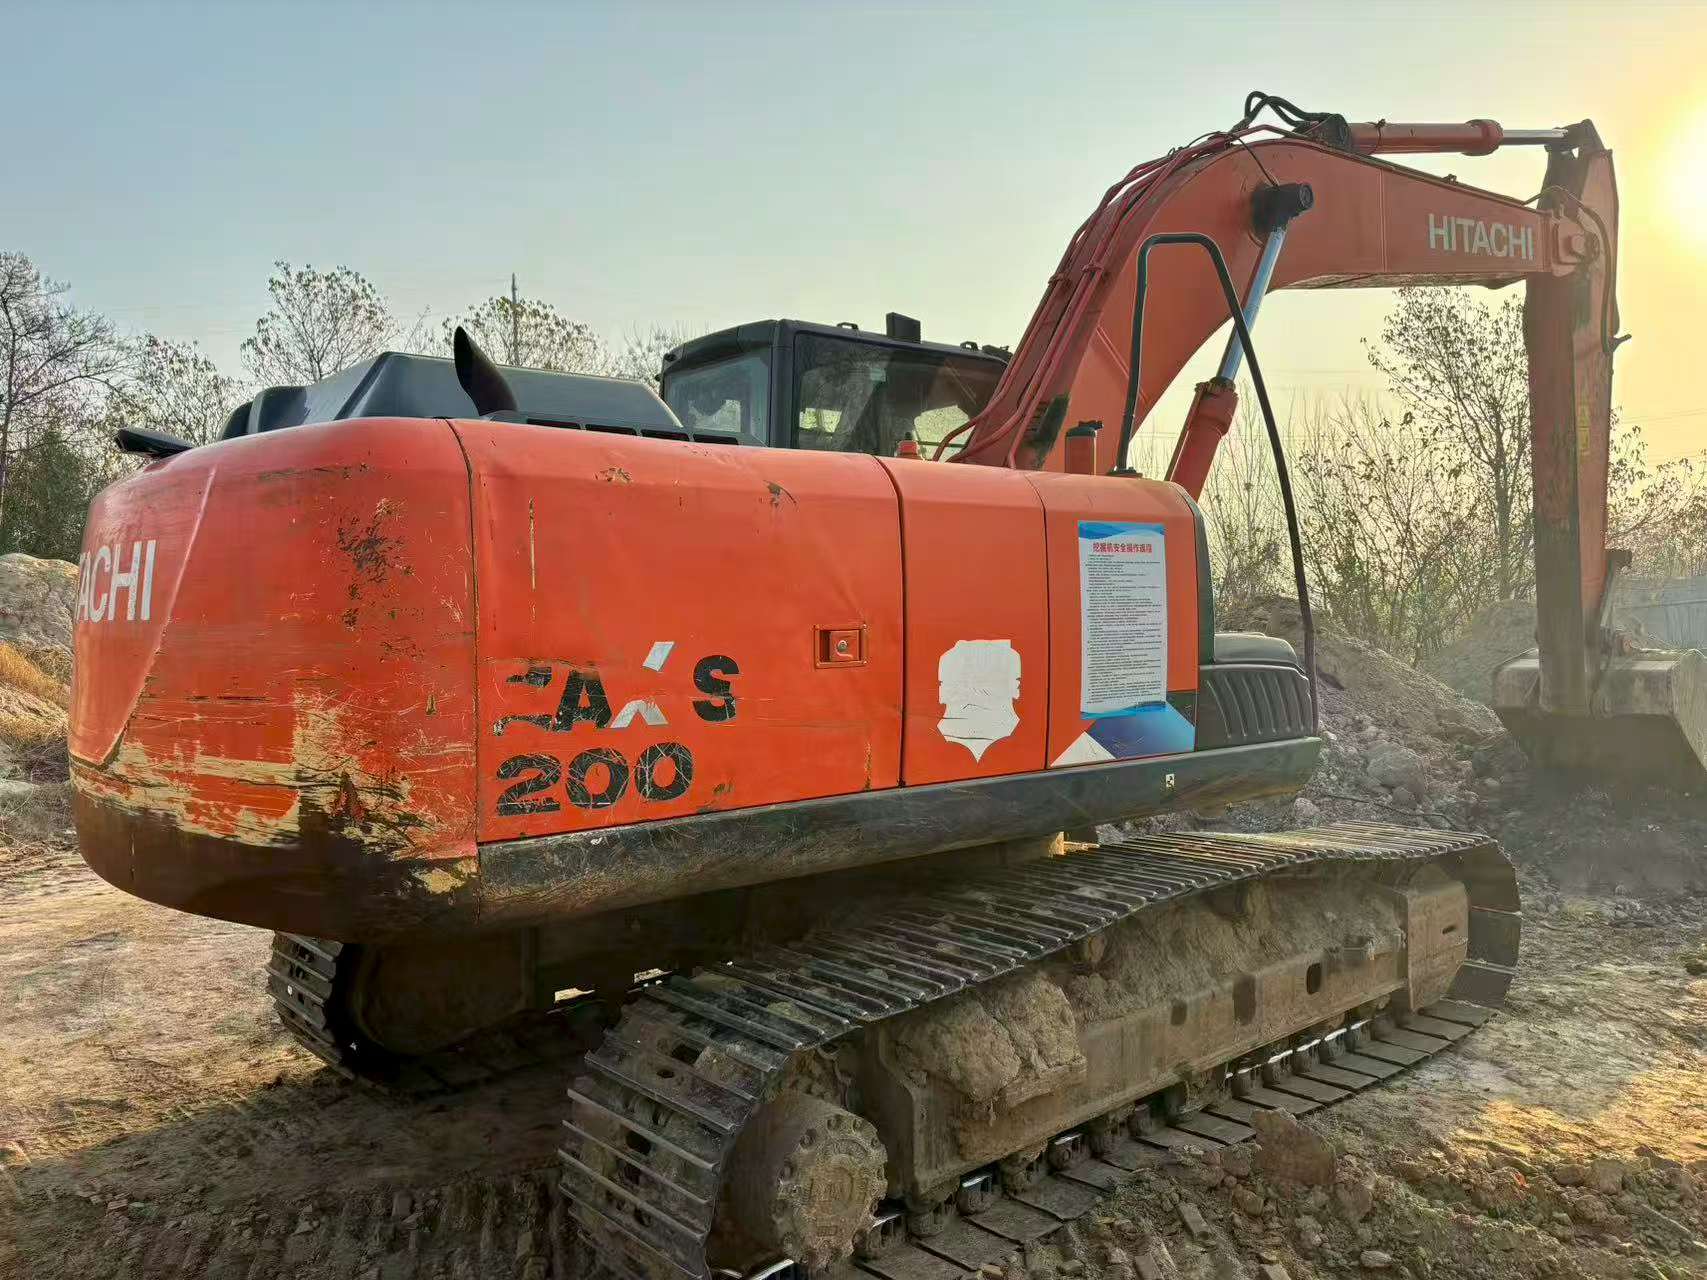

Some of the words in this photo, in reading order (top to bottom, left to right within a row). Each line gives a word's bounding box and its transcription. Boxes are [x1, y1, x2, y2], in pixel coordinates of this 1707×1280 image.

[1428, 212, 1535, 261] HITACHI
[74, 539, 157, 623] ACHI
[496, 741, 693, 817] 200
